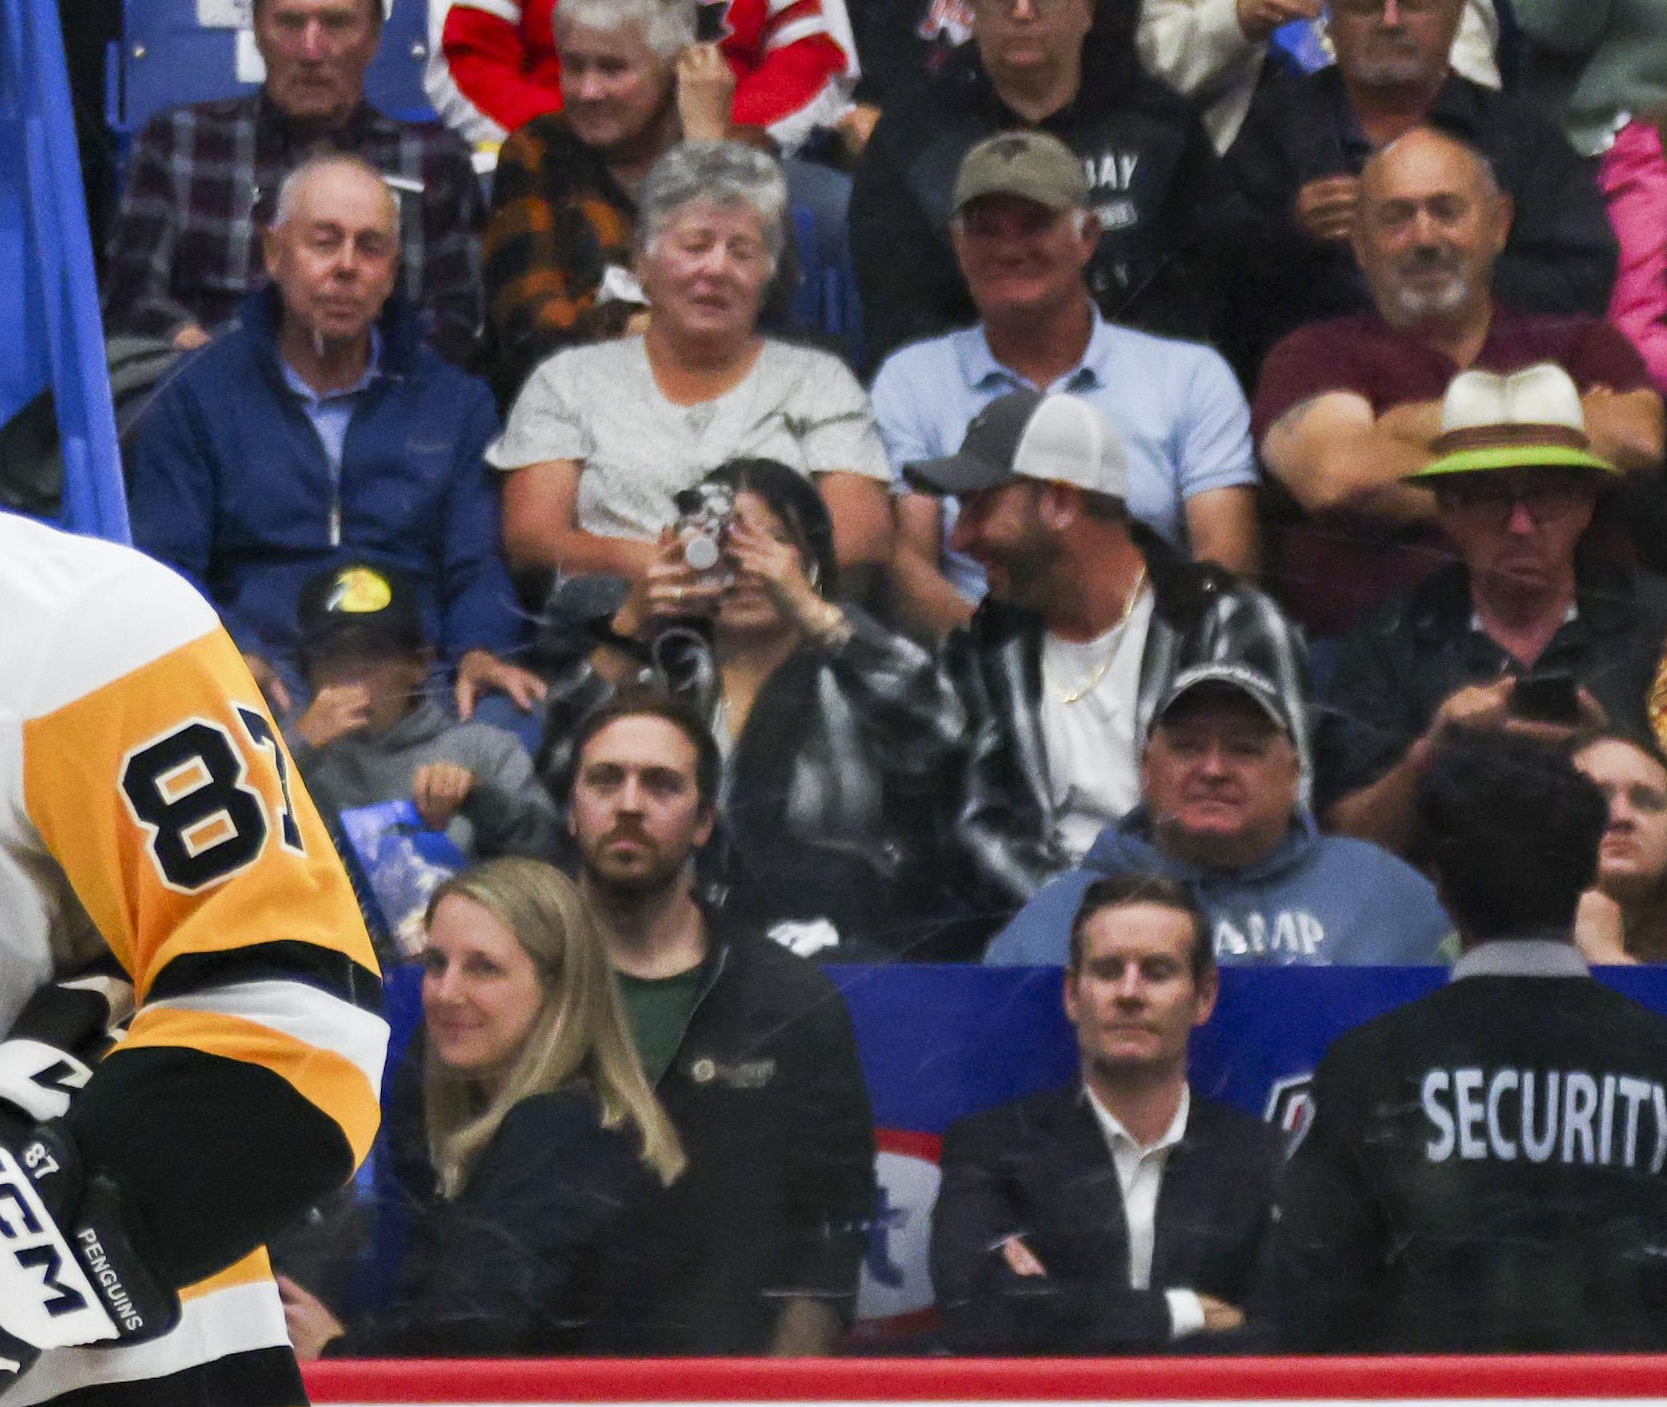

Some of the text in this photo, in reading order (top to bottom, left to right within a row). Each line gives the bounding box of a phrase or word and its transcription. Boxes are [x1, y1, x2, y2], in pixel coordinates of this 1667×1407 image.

[117, 700, 308, 895] 87
[1213, 911, 1325, 956] AMP
[25, 1143, 60, 1180] 87
[1421, 1066, 1667, 1174] SECURITY
[77, 1227, 144, 1331] PENGUINS
